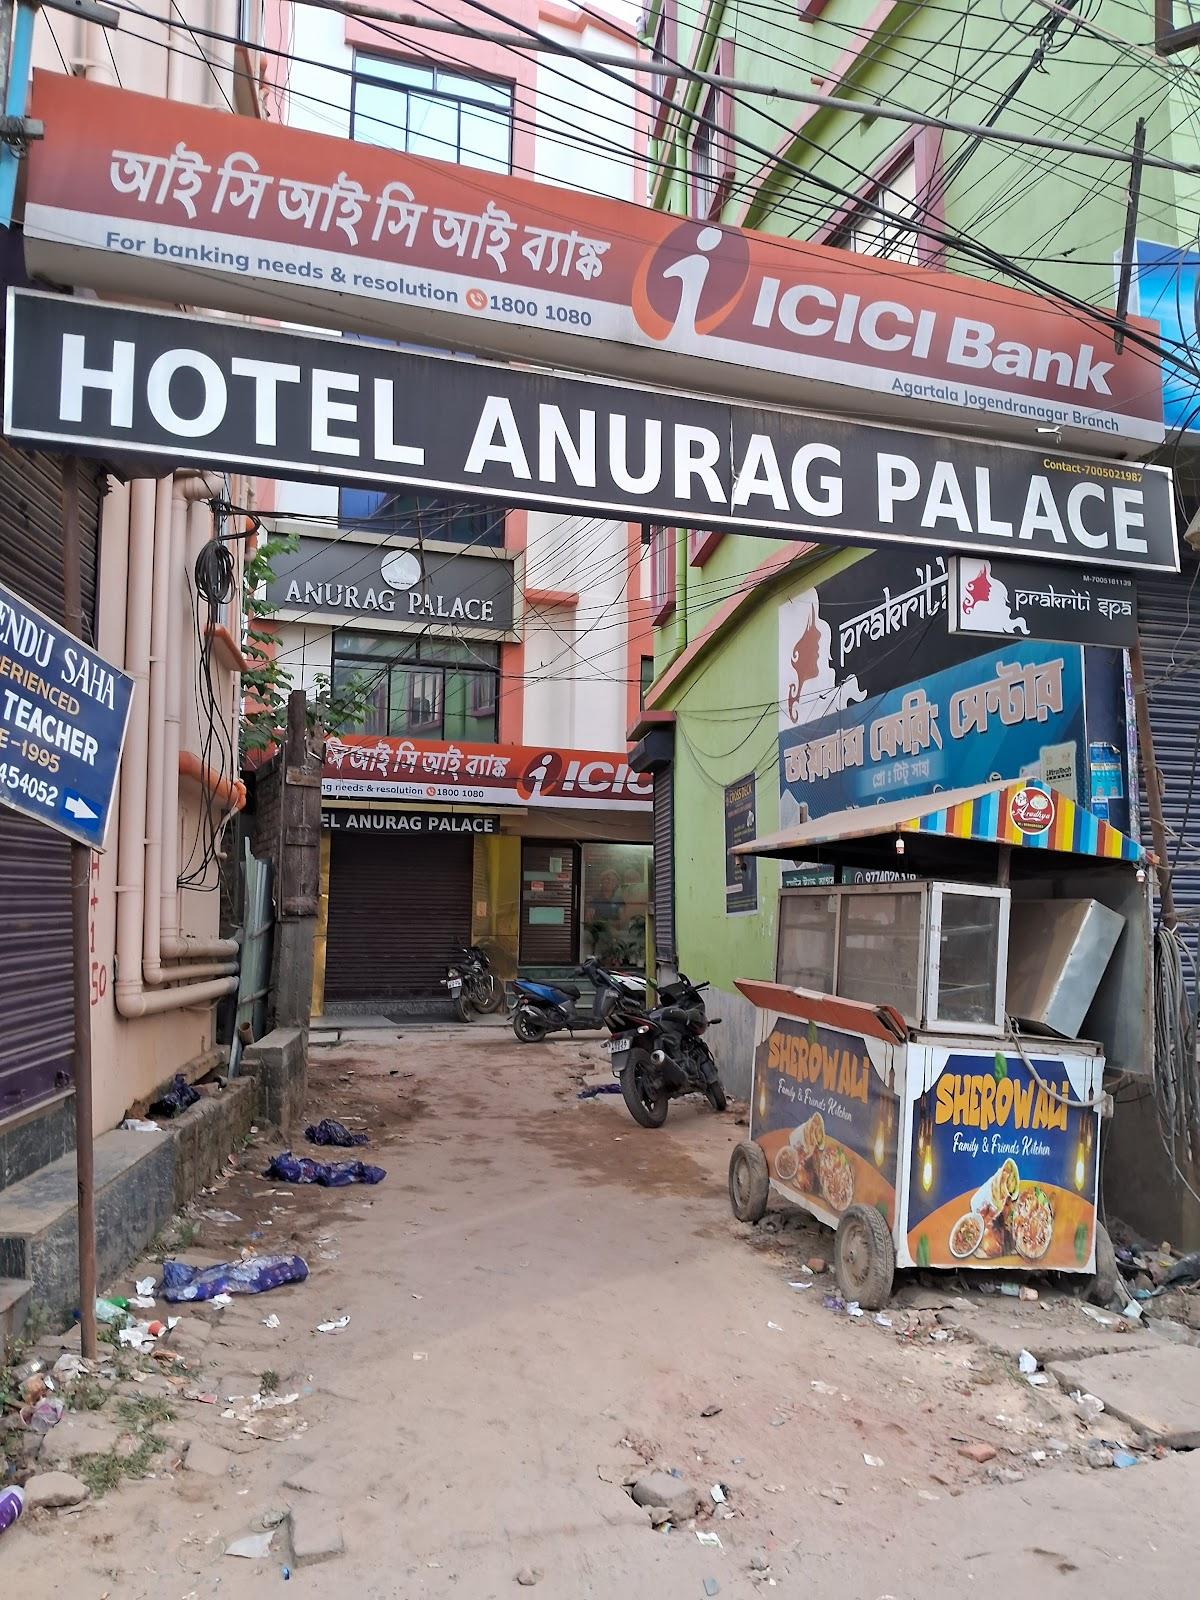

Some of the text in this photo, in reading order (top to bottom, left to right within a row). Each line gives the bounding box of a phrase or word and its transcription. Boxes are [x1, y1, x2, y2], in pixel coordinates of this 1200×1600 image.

[109, 142, 612, 281] আই সি আই সি আই ব্যাঙ্ক
[105, 230, 593, 328] For banking needs & resolution 1800 1080
[751, 275, 1116, 396] ICICI Bank
[891, 377, 1120, 433] Agartala Jogendranagar Branch
[58, 333, 1150, 554] HOTEL ANURAG PALACE
[284, 579, 495, 623] ANURAG PALACE
[838, 556, 949, 668] prakriti
[1014, 584, 1132, 621] prakriti spa
[0, 655, 80, 716] ERIENCED
[61, 647, 115, 711] SAHA
[3, 688, 98, 766] TEACHER
[335, 782, 364, 793] needs
[376, 784, 424, 796] resolution
[437, 787, 460, 798] 1800
[462, 788, 485, 799] 1080
[561, 760, 654, 795] ICIC
[346, 812, 423, 831] ANURAG
[427, 816, 494, 833] PALACE
[952, 1131, 1050, 1158] Family & Friends Kitchen
